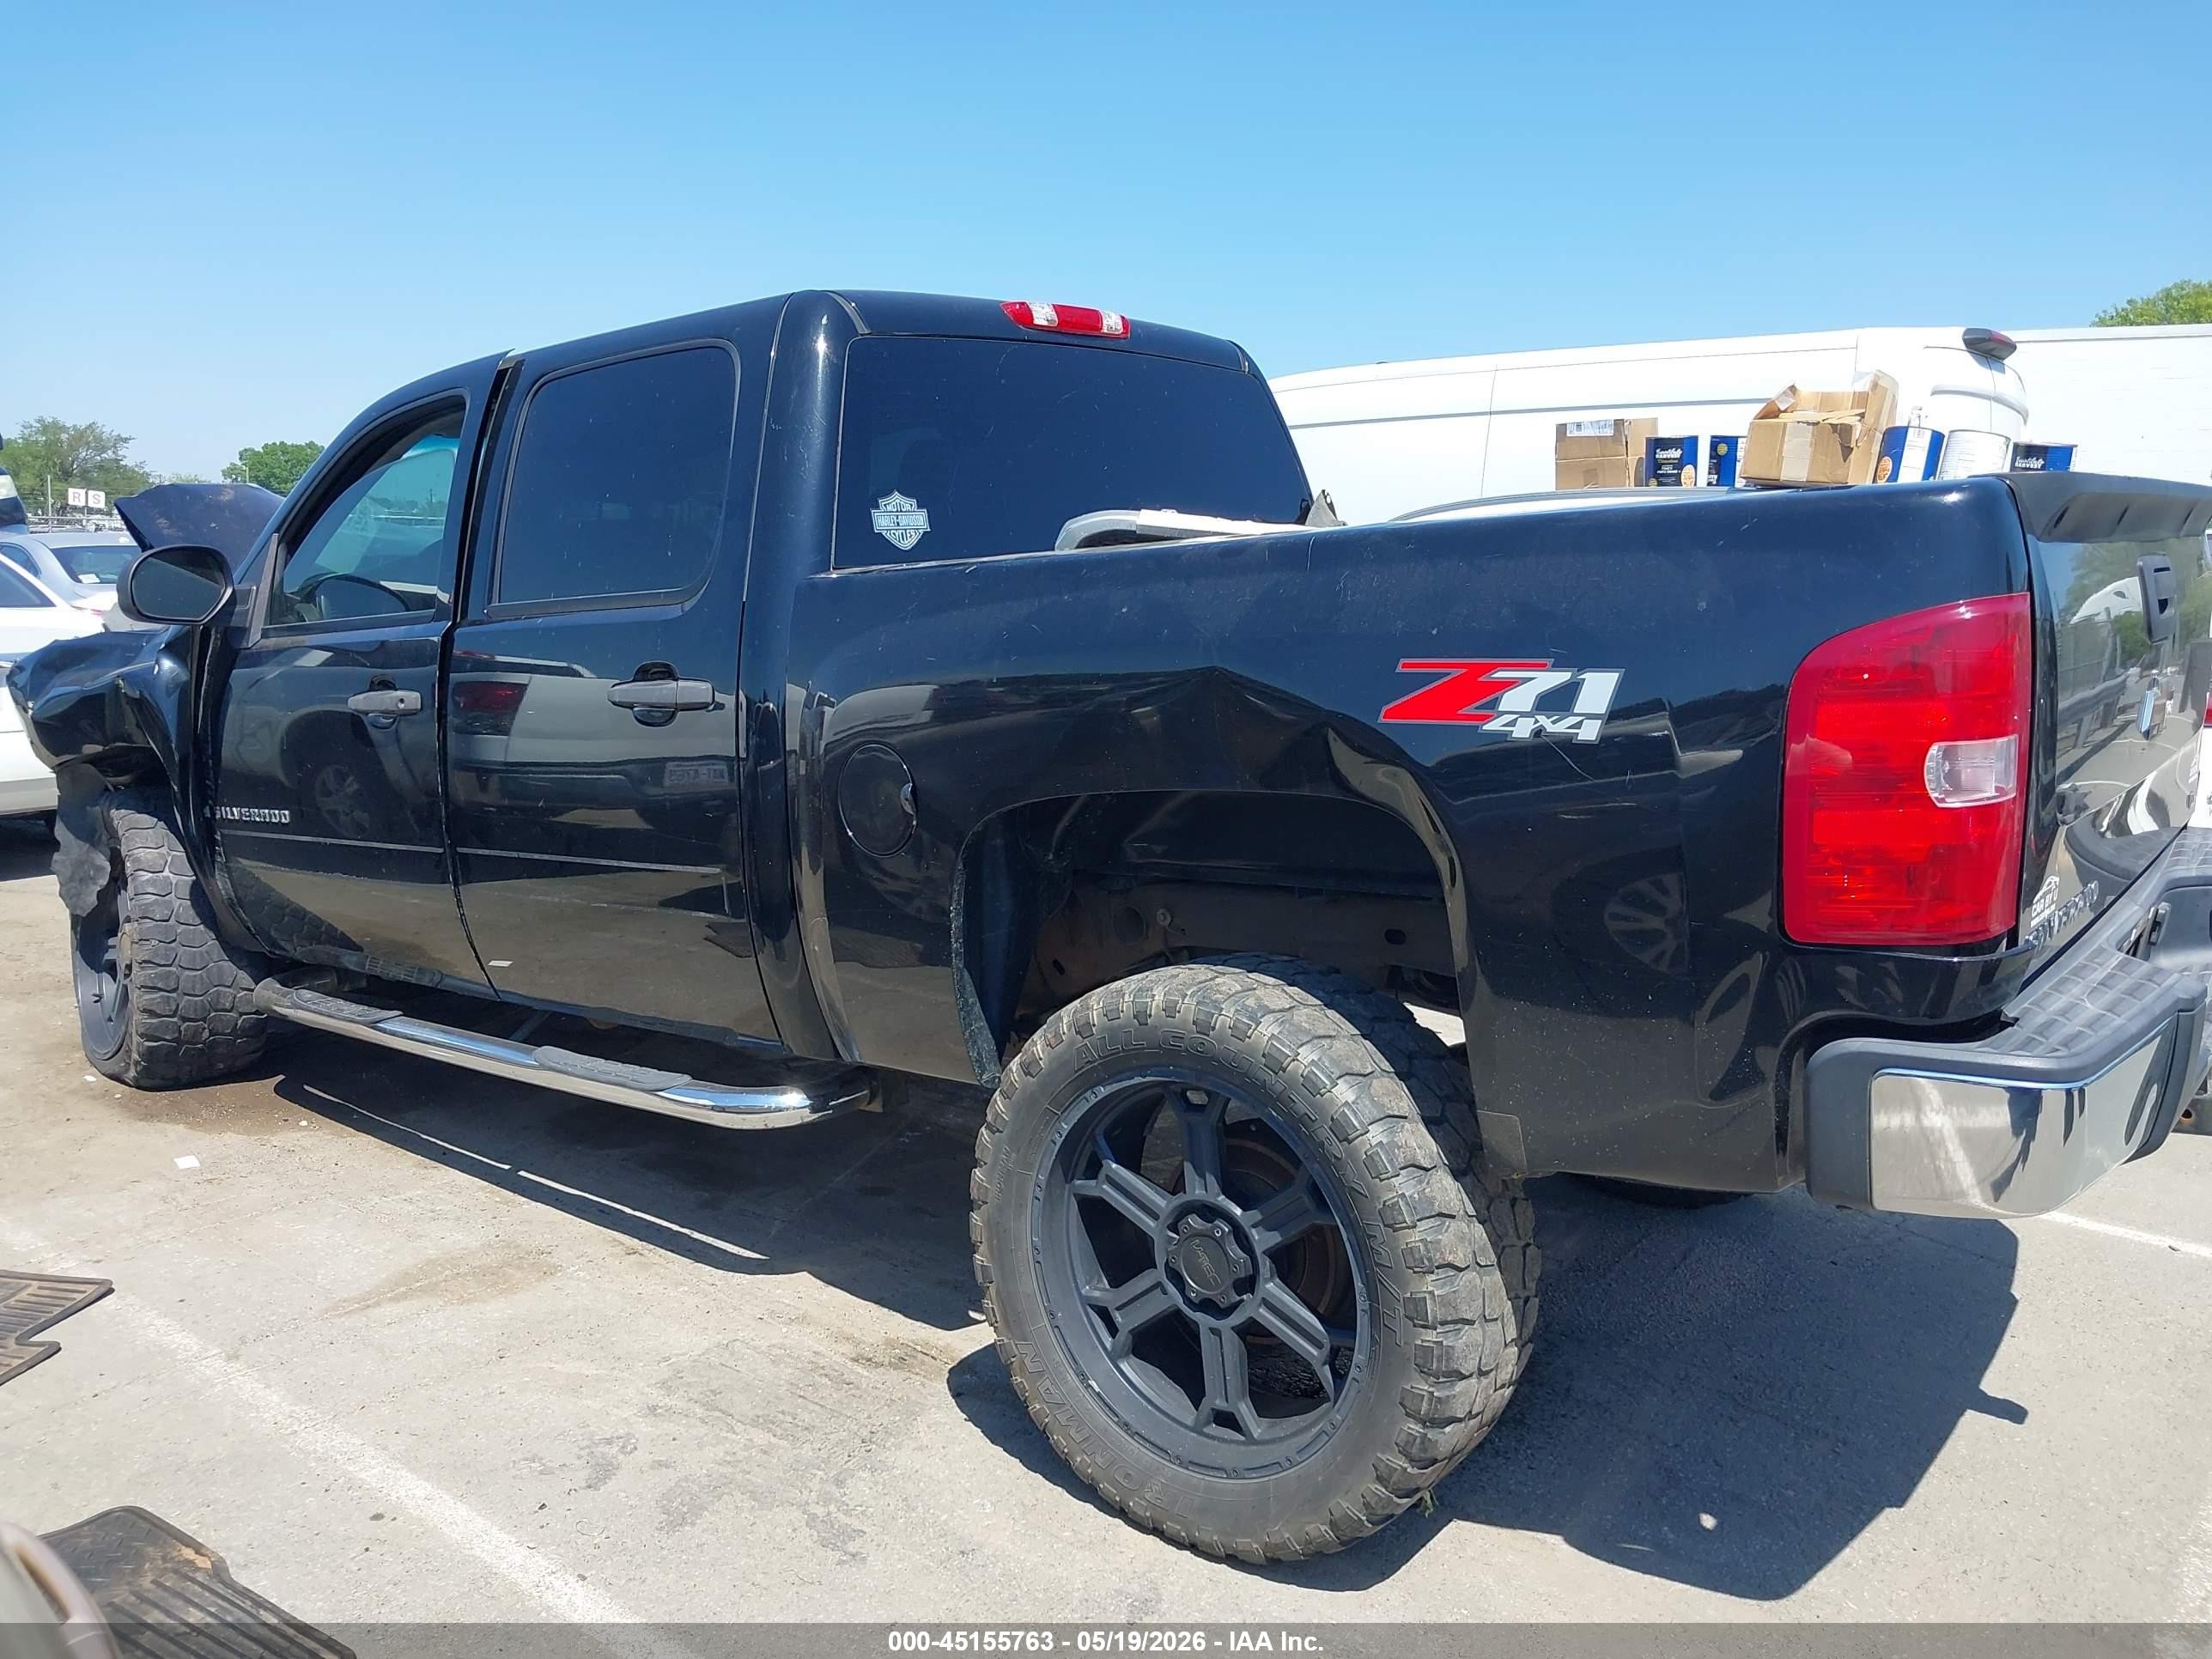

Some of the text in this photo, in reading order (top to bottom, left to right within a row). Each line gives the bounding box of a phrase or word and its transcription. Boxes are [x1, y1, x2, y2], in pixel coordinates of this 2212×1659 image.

[72, 491, 101, 505] R S
[885, 499, 912, 512] MOTOR
[877, 514, 925, 526] HARLEY-DAVIDSON
[890, 530, 915, 543] CYCLES
[1380, 659, 1624, 723] Z71
[2032, 898, 2045, 918] CAR
[1073, 1030, 1402, 1347] ALL COUNTRY M/T
[1015, 1341, 1191, 1519] IRONMAN
